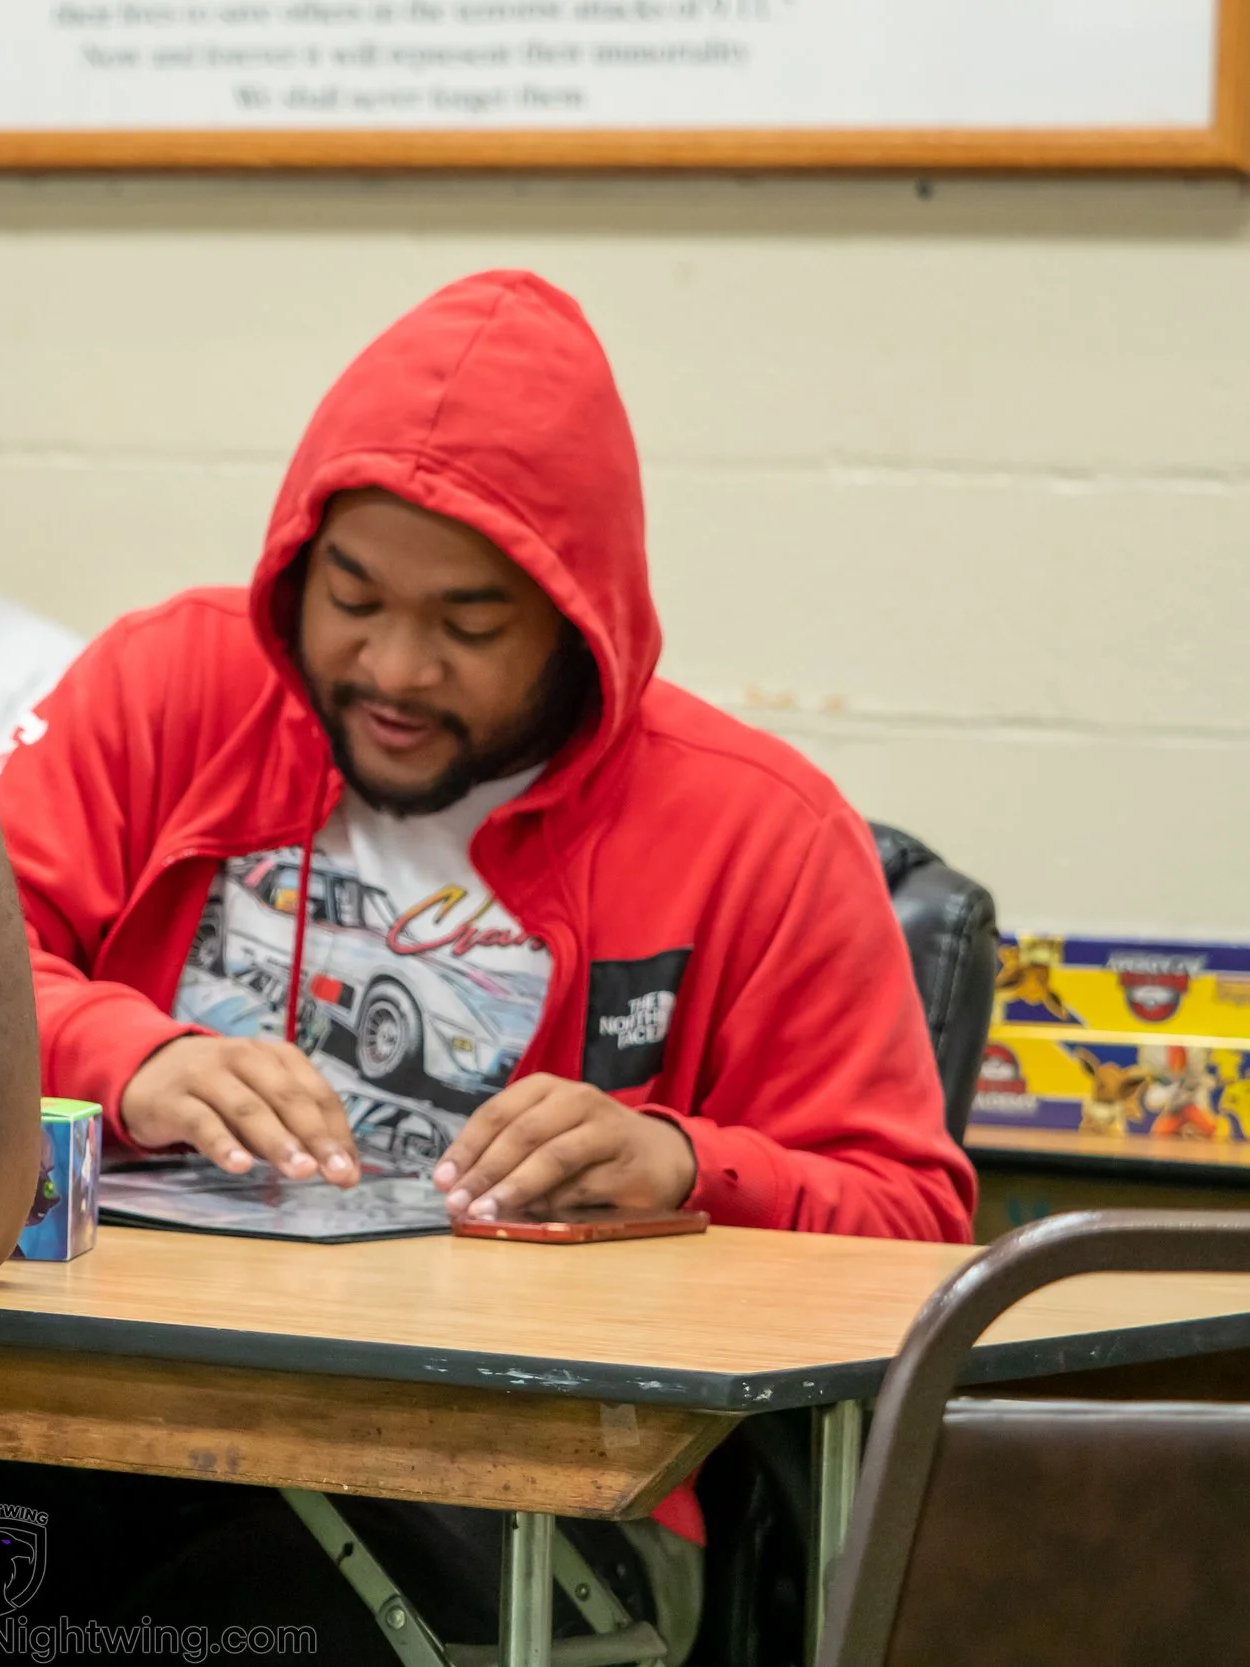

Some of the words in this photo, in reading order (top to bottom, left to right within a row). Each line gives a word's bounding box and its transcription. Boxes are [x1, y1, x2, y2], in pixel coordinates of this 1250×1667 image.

[627, 992, 656, 1015] THE
[599, 1007, 657, 1037] NORTH
[617, 1025, 658, 1050] FACE
